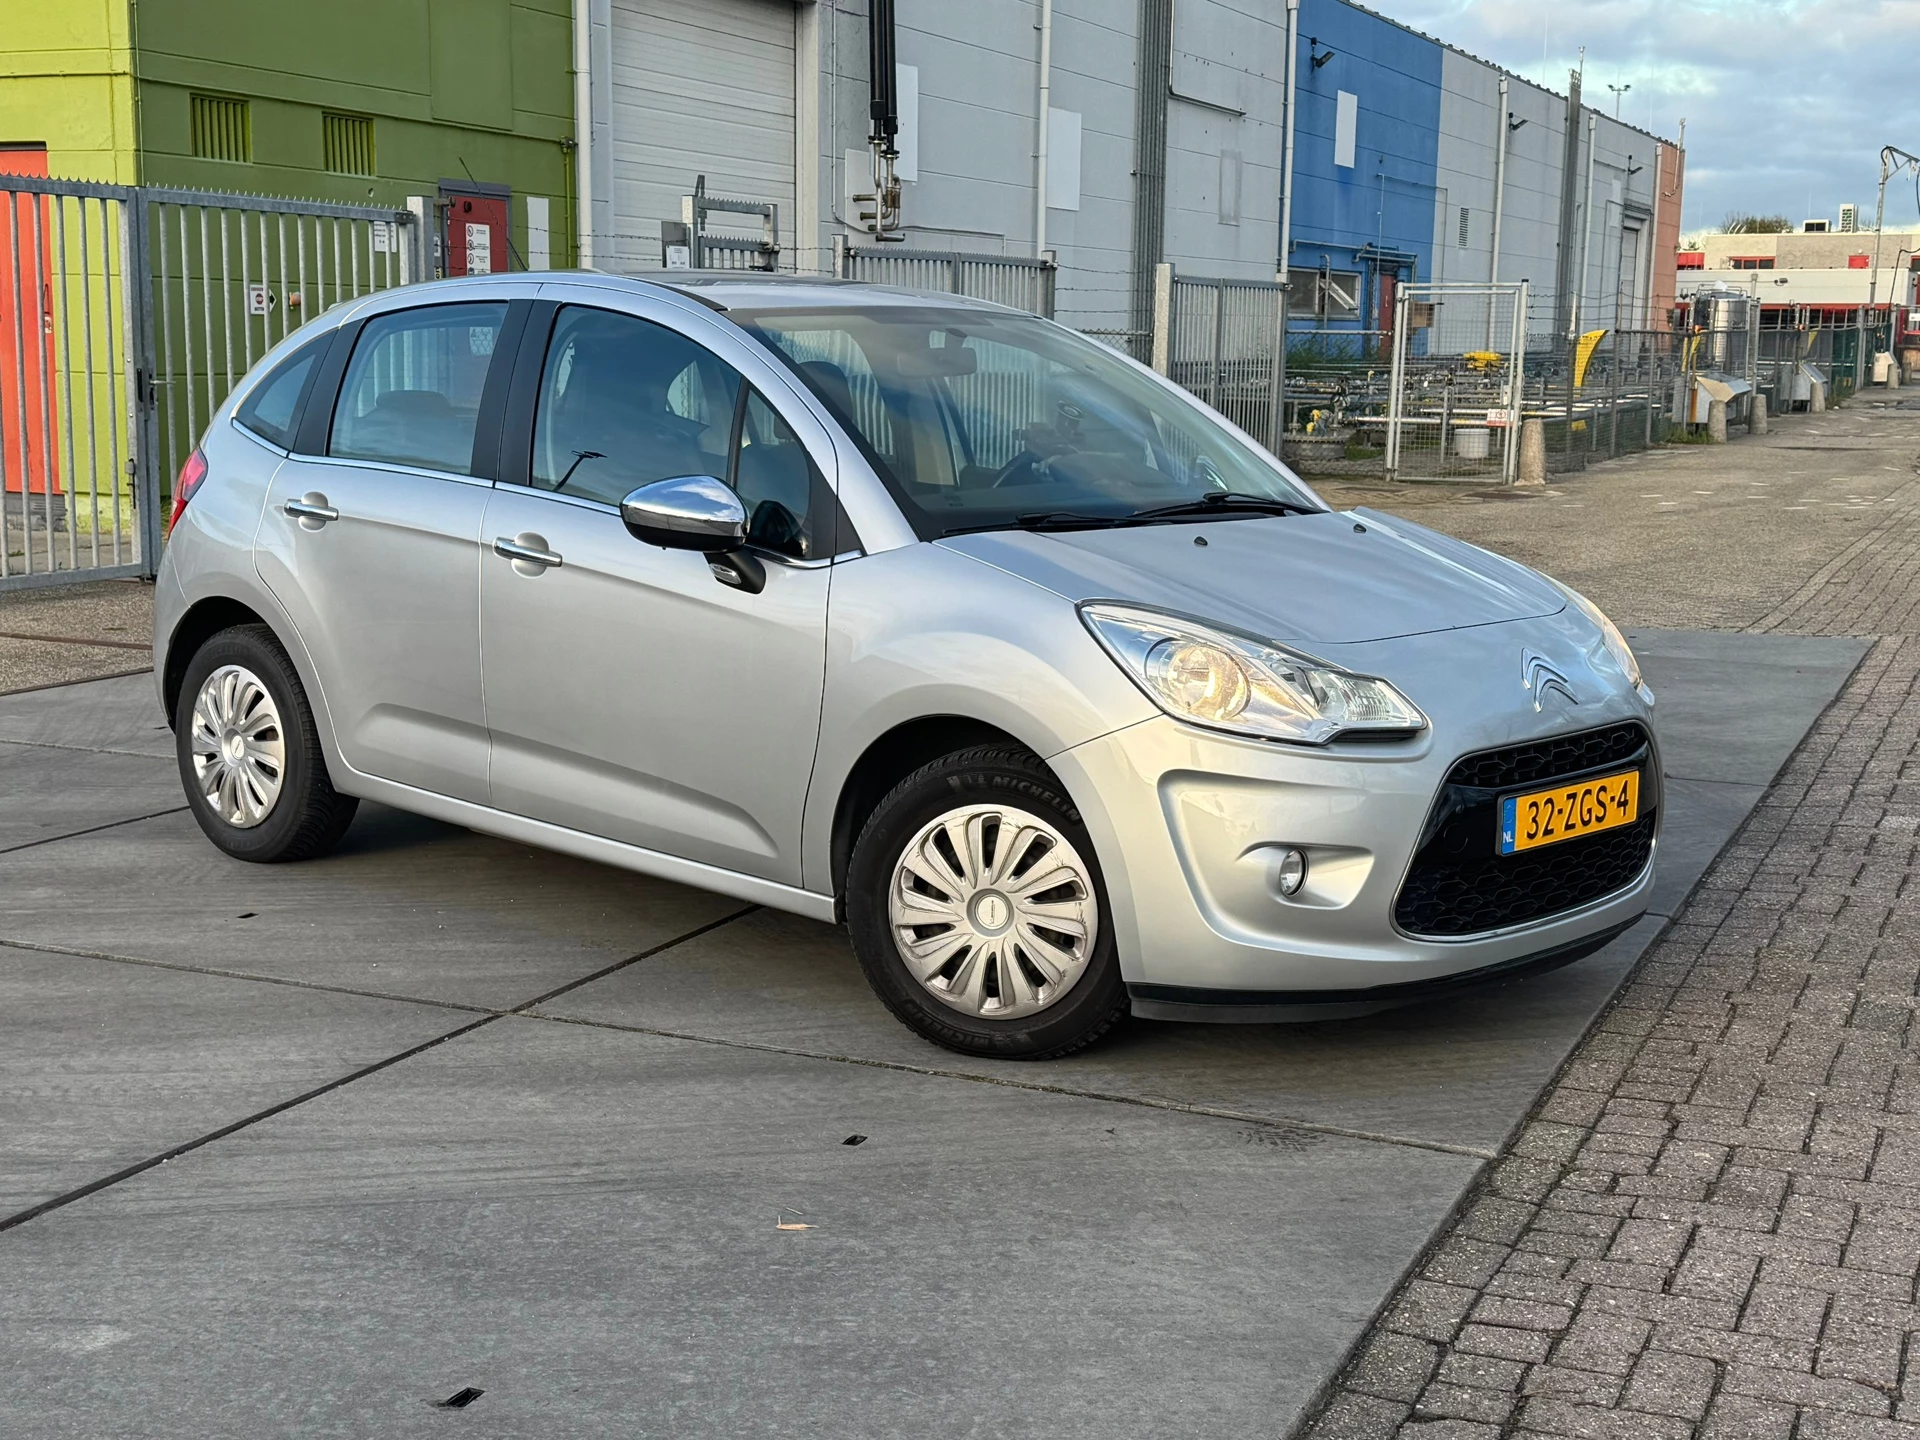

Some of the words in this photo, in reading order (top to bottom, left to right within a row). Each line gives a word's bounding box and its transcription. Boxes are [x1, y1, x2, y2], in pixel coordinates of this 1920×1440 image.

[992, 776, 1081, 822] MICHELIN
[1502, 831, 1514, 843] NL
[1526, 779, 1629, 840] 32-ZGS-4
